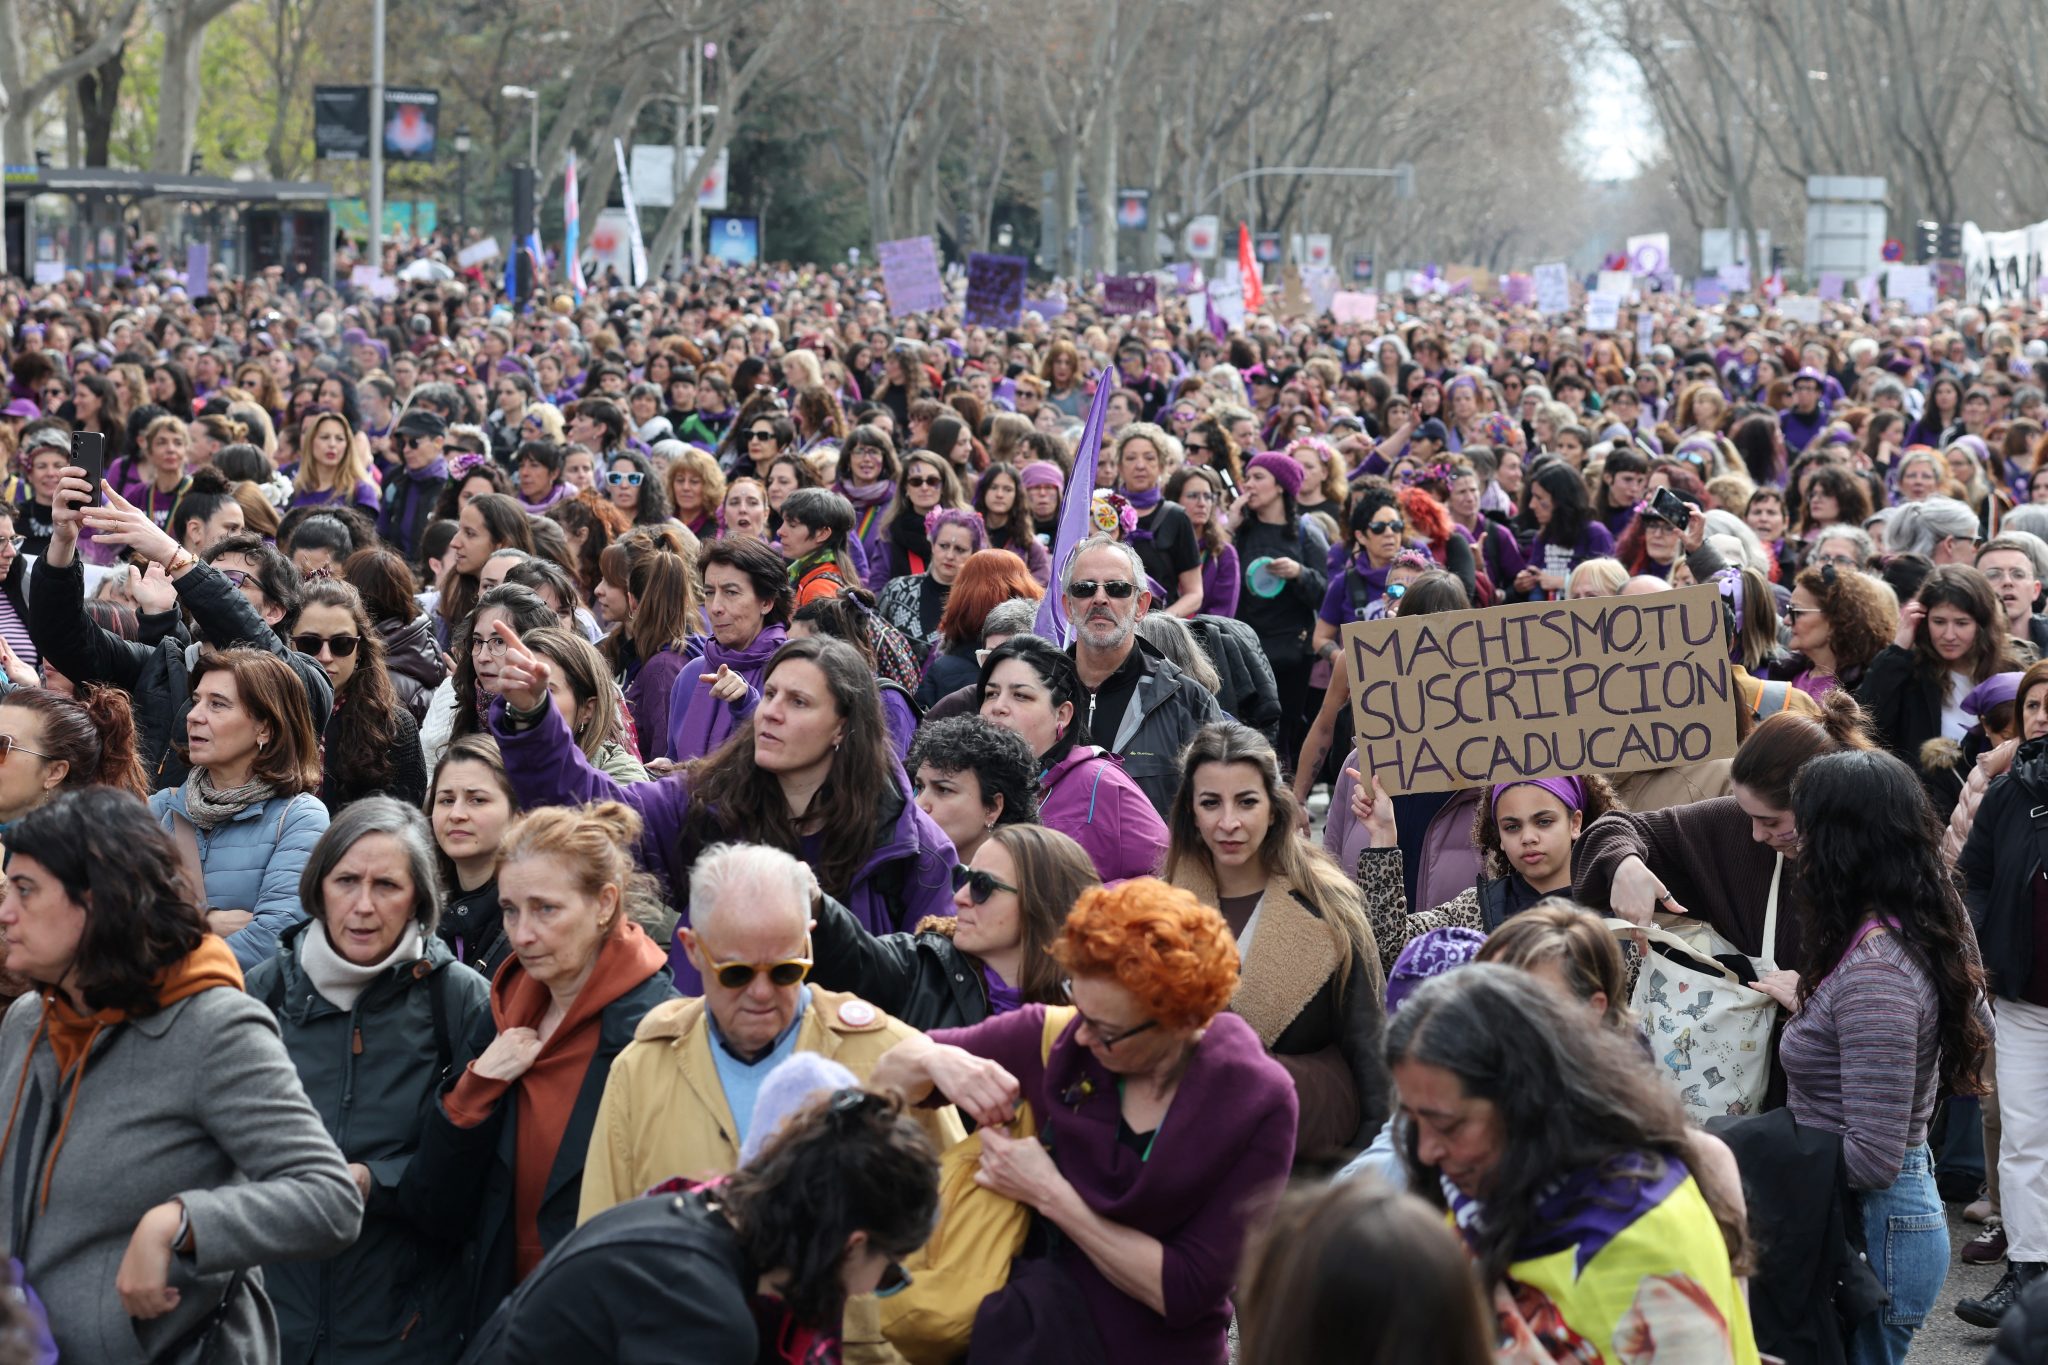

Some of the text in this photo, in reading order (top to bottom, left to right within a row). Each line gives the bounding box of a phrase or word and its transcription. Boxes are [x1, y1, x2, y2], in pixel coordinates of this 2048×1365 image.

[1353, 600, 1718, 682] MACHISMO, TU
[1361, 651, 1728, 740] SUSCRIPCIÓN
[1367, 722, 1712, 790] HA CADUCADO
